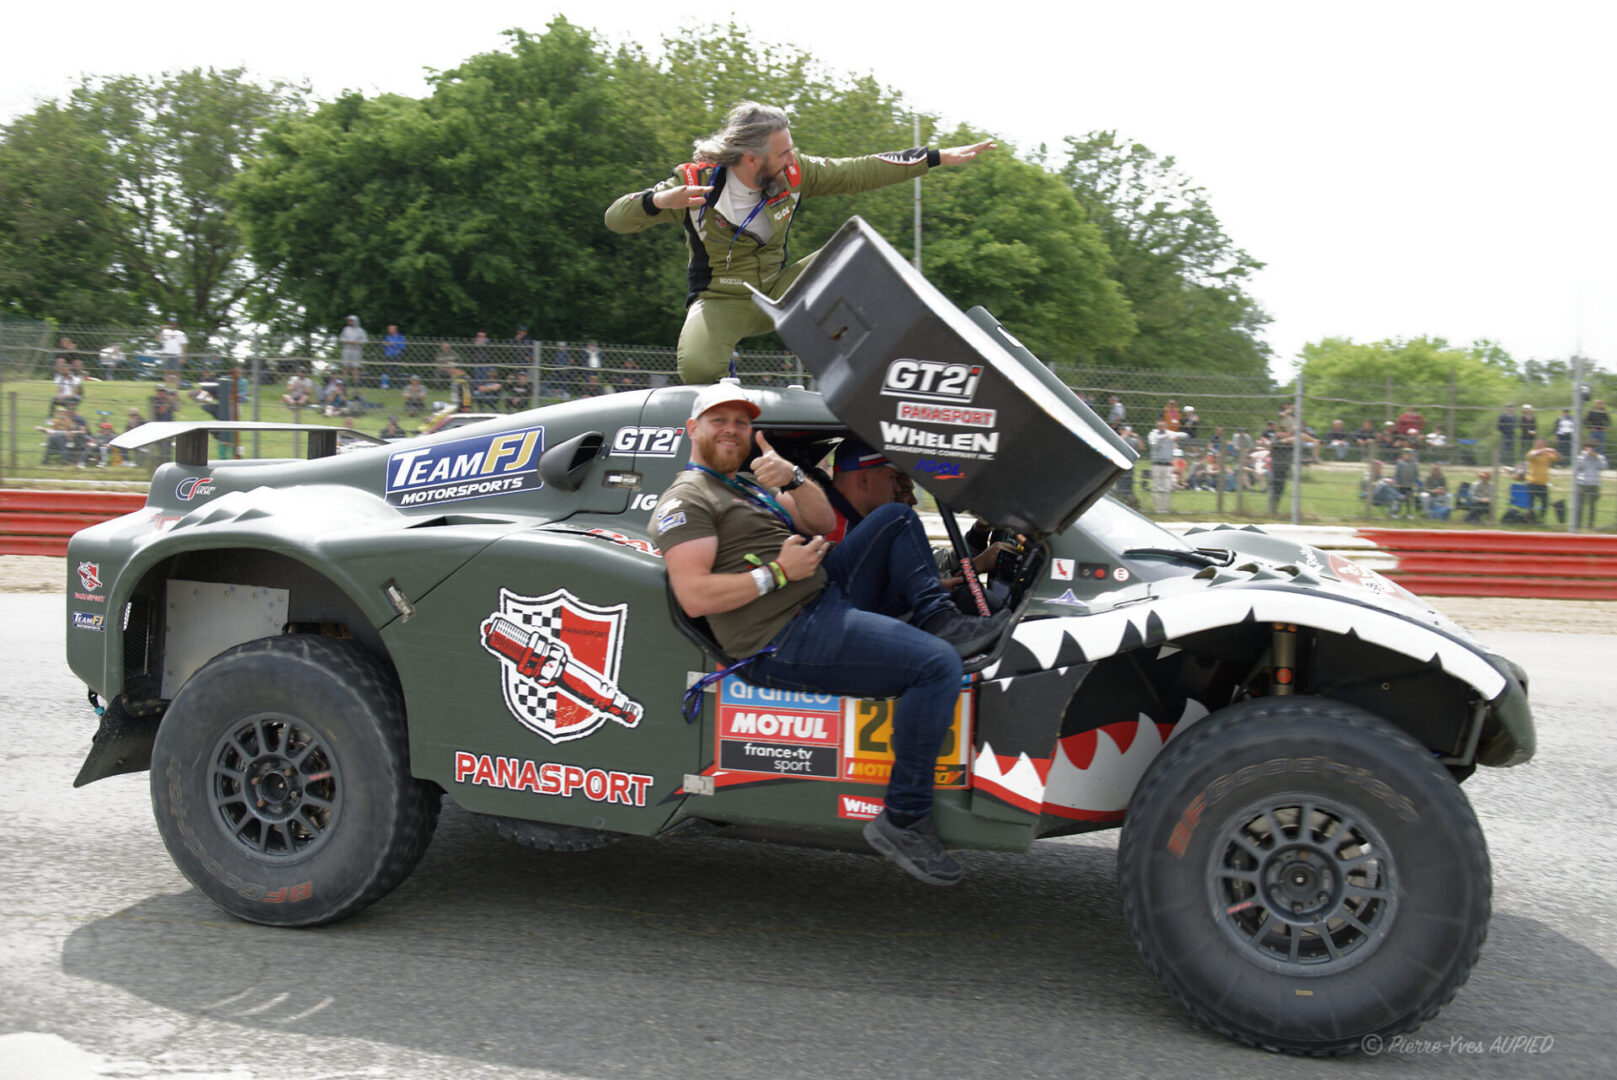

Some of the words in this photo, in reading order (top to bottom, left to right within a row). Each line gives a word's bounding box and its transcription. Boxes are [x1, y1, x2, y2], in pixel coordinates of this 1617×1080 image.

[886, 359, 982, 396] GT2i
[900, 405, 993, 425] PANASPORT
[611, 426, 685, 452] GT2i
[879, 420, 999, 453] WHELEN
[914, 459, 961, 475] IGOL
[400, 476, 524, 505] MOTORSPORTS
[730, 712, 828, 739] MOTUL
[455, 751, 653, 807] PANASPORT
[774, 760, 812, 773] sport
